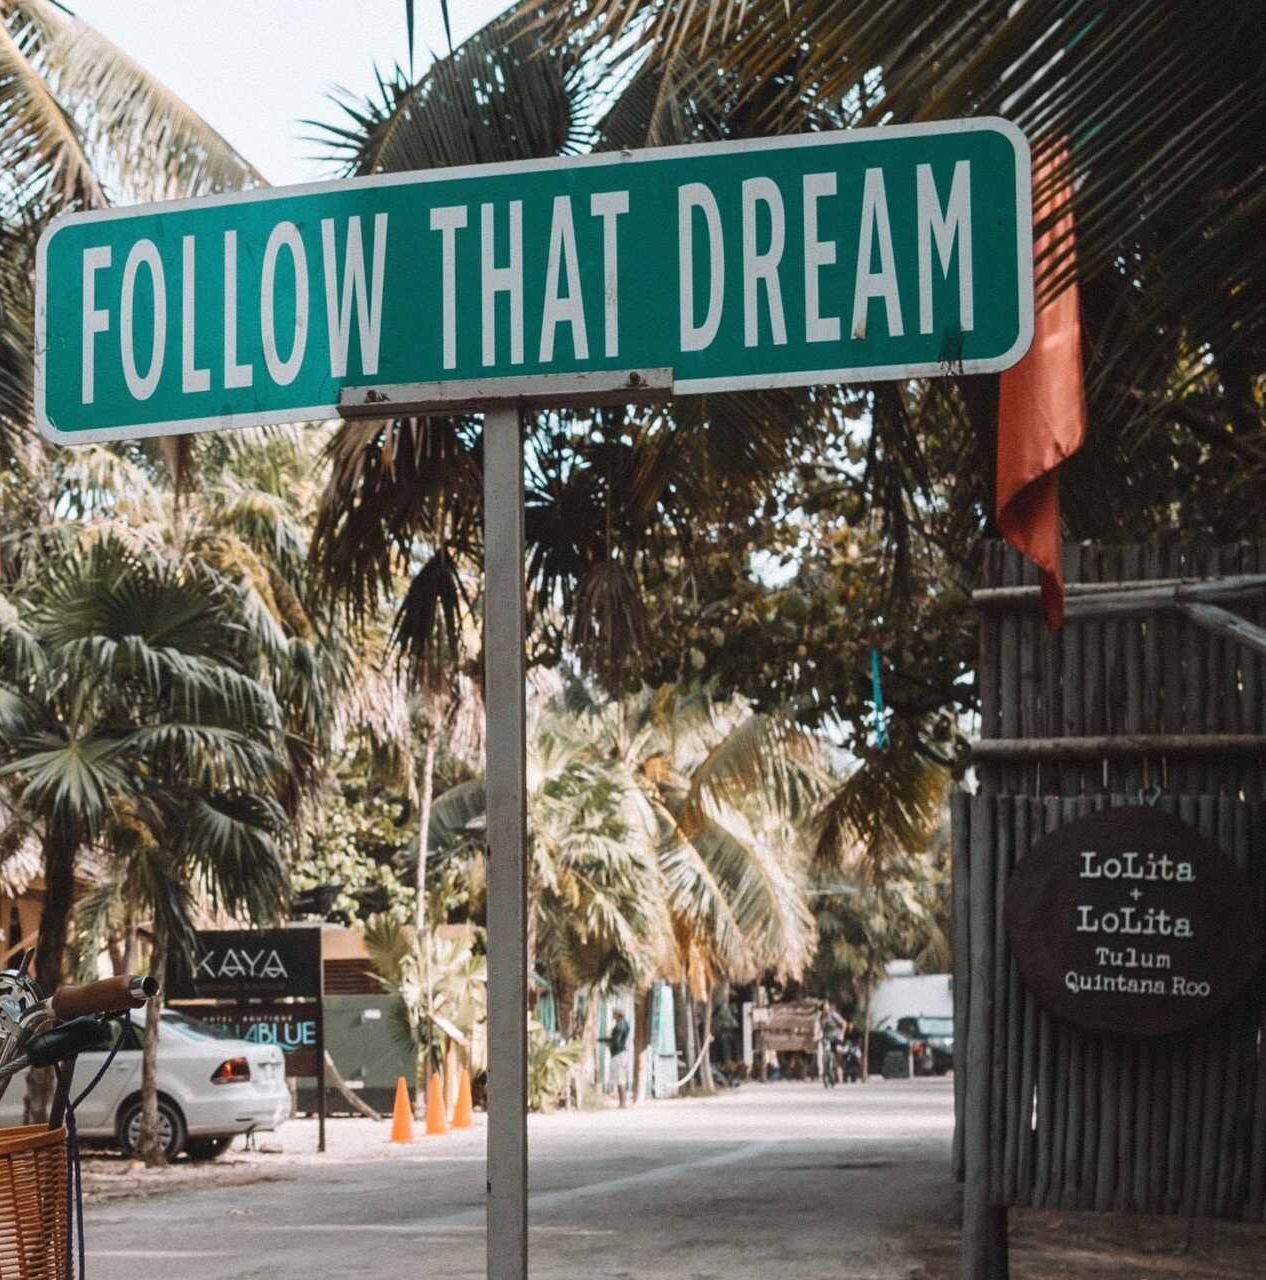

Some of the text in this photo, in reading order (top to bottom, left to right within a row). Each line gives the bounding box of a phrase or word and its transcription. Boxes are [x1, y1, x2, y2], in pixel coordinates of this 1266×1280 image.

[80, 159, 975, 405] FOLLOW THAT DREAM
[1080, 852, 1195, 881] LoLita
[1076, 905, 1194, 937] LoLita
[192, 948, 288, 978] KAYA
[1095, 947, 1171, 968] Tulum
[1065, 971, 1210, 996] Quintana Roo
